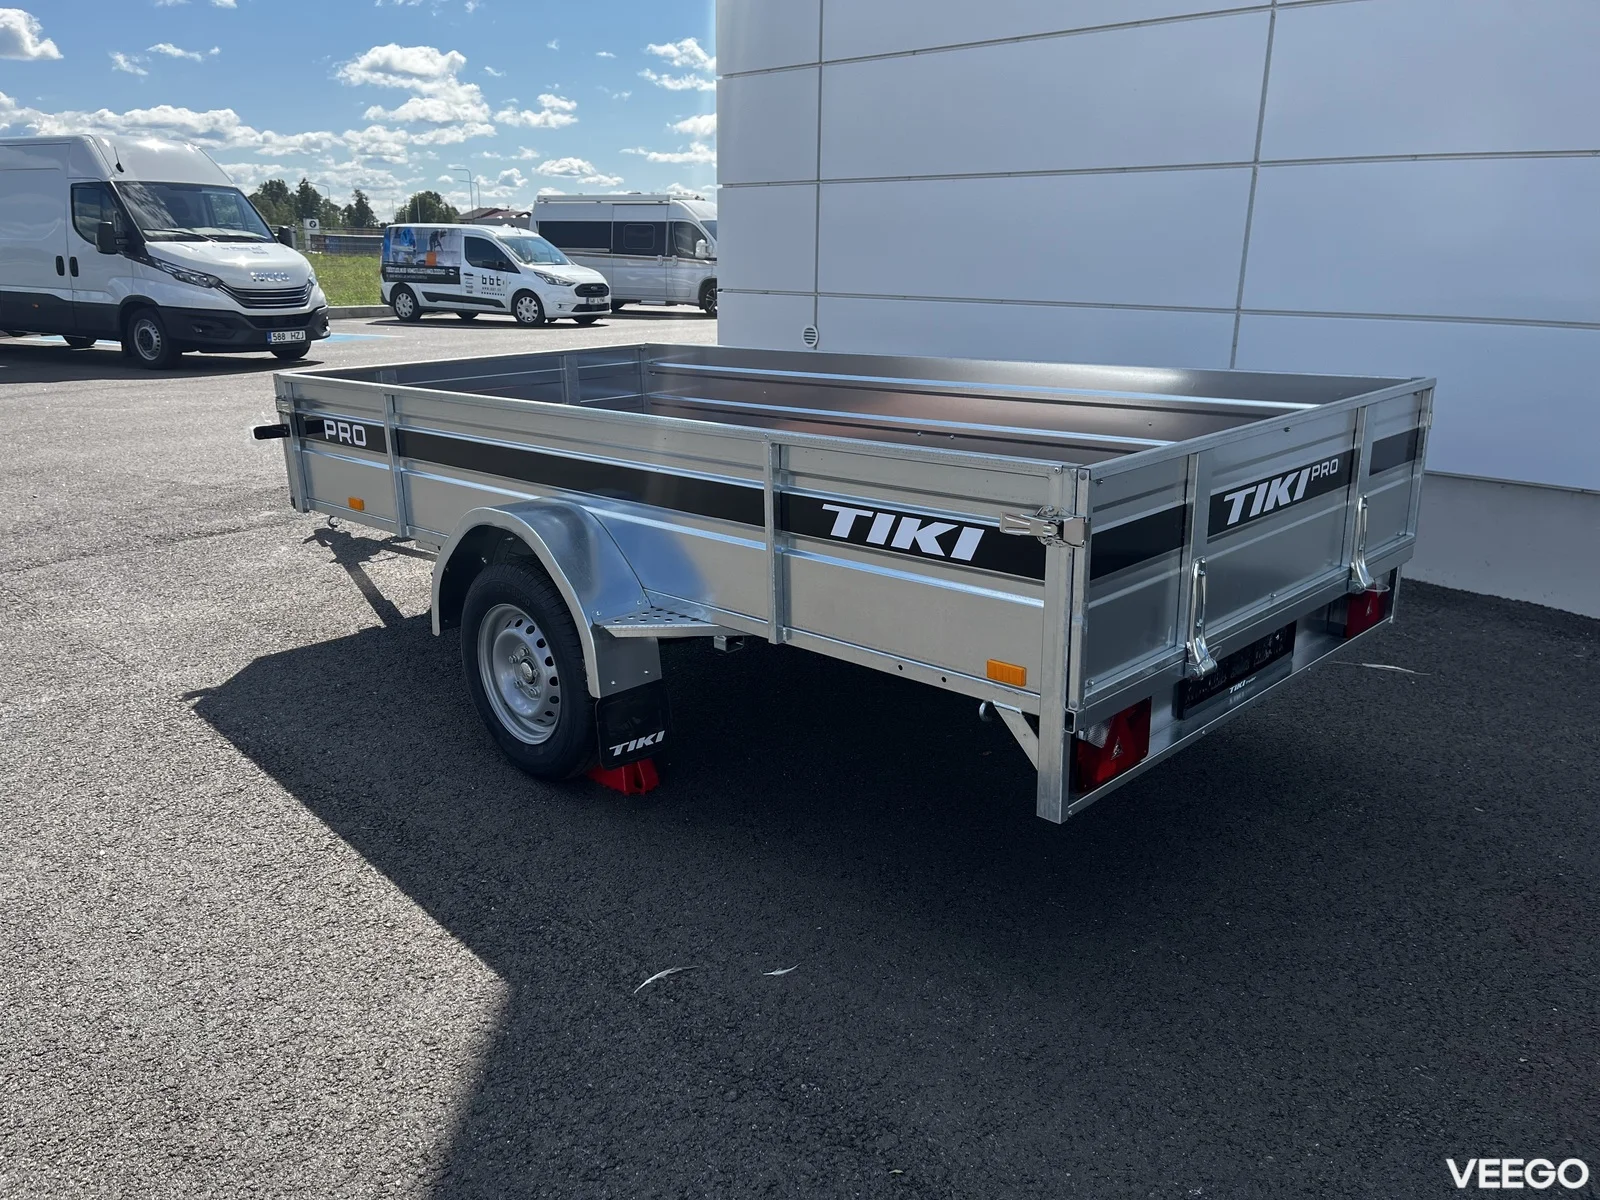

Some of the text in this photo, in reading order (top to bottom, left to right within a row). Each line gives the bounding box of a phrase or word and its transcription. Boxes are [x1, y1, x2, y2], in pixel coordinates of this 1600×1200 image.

[481, 274, 501, 286] bbt
[272, 331, 305, 341] 588 HZJ
[323, 419, 367, 447] PRO
[1223, 458, 1339, 526] TIKI PRO
[821, 503, 985, 562] TIKI
[608, 730, 666, 757] TIKI
